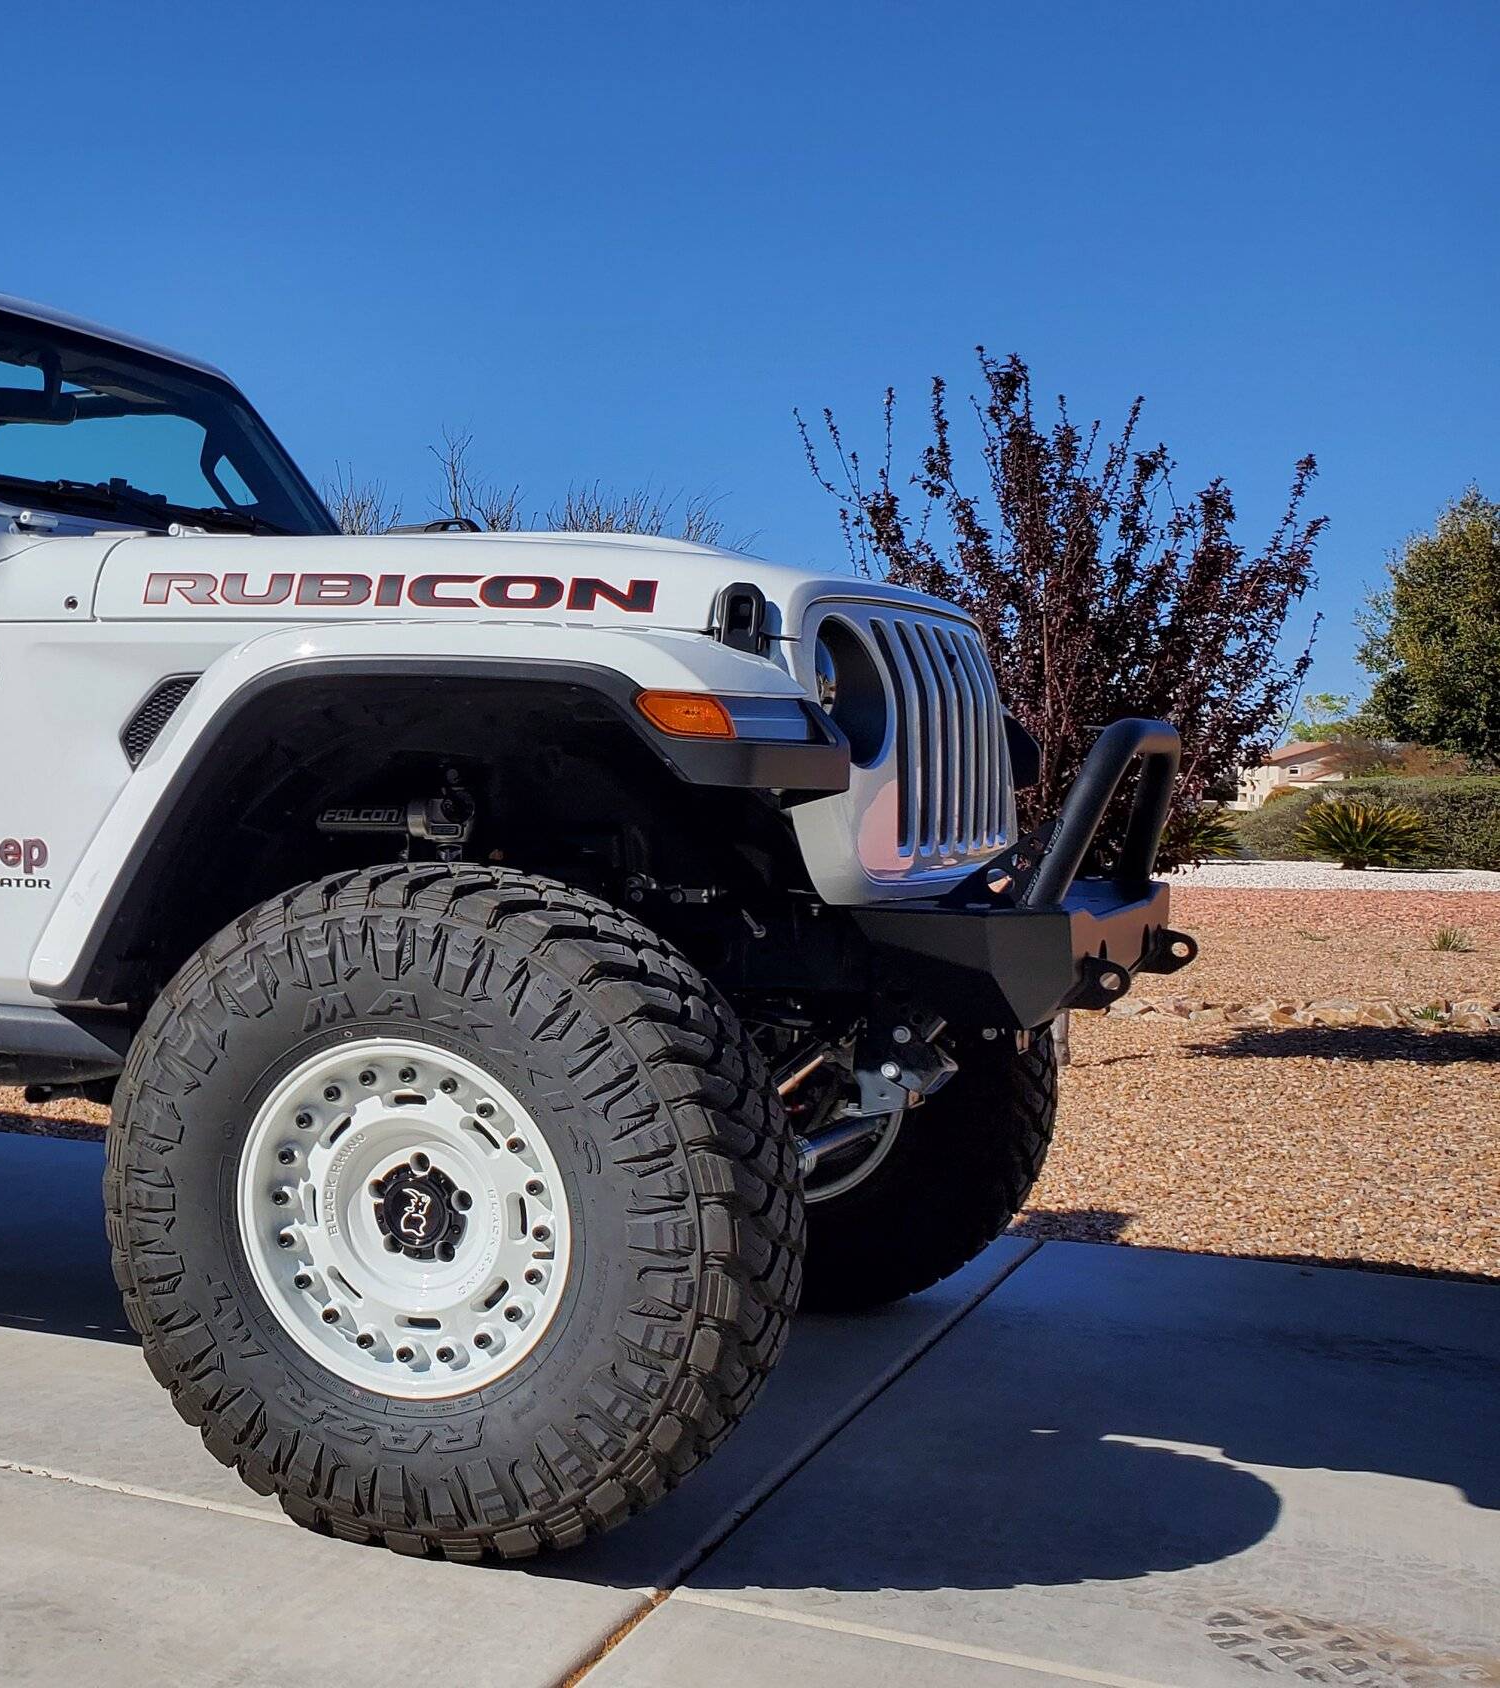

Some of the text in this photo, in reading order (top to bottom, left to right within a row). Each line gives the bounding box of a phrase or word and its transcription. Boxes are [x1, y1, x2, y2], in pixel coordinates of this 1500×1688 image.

[141, 571, 659, 613] RUBICON
[322, 809, 399, 822] FALCON
[302, 988, 604, 1175] MAXXIS
[325, 1132, 367, 1237] BLACK RHINO
